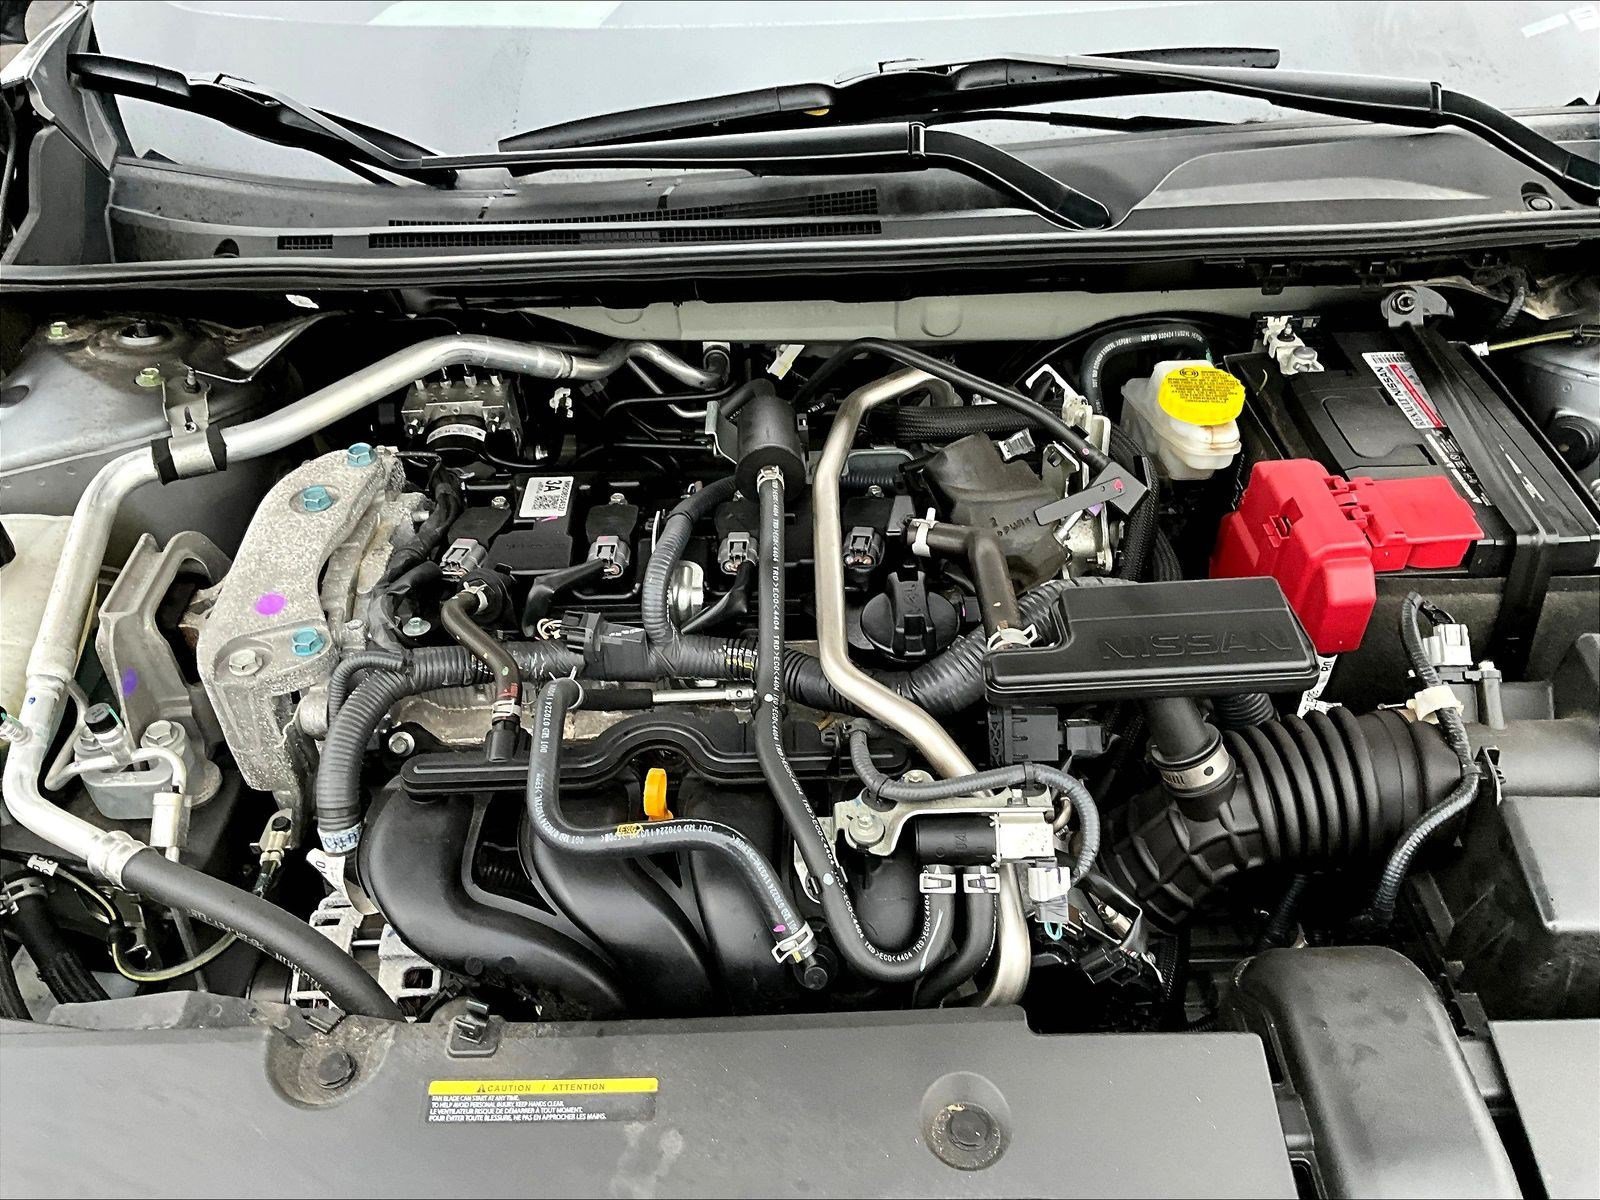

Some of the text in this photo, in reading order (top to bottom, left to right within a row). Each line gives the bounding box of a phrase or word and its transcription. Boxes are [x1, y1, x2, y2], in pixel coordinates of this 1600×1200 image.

[1375, 365, 1403, 398] NISSAN
[543, 479, 562, 492] 3A
[1103, 632, 1293, 660] NISSAN
[863, 940, 913, 963] TRD>ECO<4404
[912, 894, 930, 954] TRD>ECO<4404
[487, 1084, 533, 1093] CAUTION
[552, 1083, 606, 1092] ATTENTION
